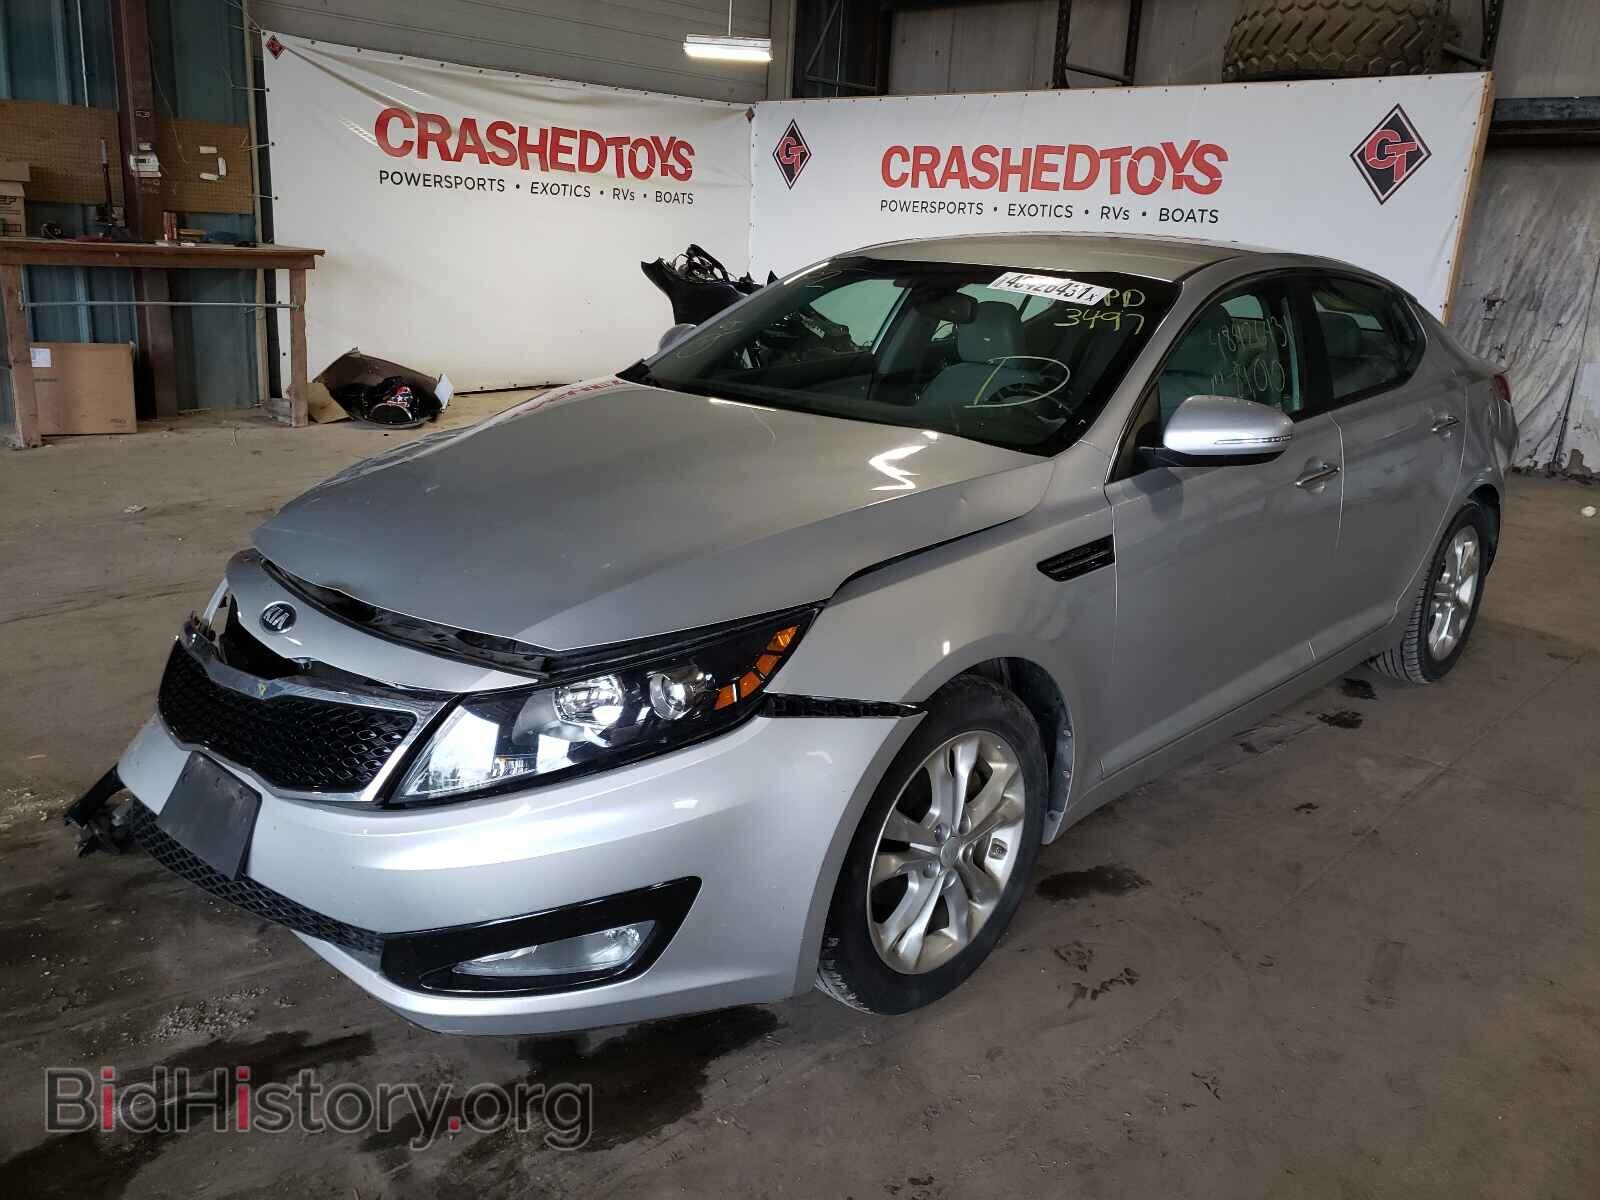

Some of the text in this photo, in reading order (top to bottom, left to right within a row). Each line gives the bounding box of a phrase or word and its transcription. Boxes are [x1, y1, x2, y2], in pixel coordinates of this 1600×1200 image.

[374, 107, 695, 182] CRASHEDTOYS
[881, 139, 1228, 196] CRASHEDTOYS
[379, 170, 694, 205] POWERSPORTS EXOTICS RVs BOATS
[880, 199, 1220, 224] POWERSPORTS EXOTICS RVs BOATS
[1053, 308, 1145, 335] 3497
[263, 606, 290, 630] KIA
